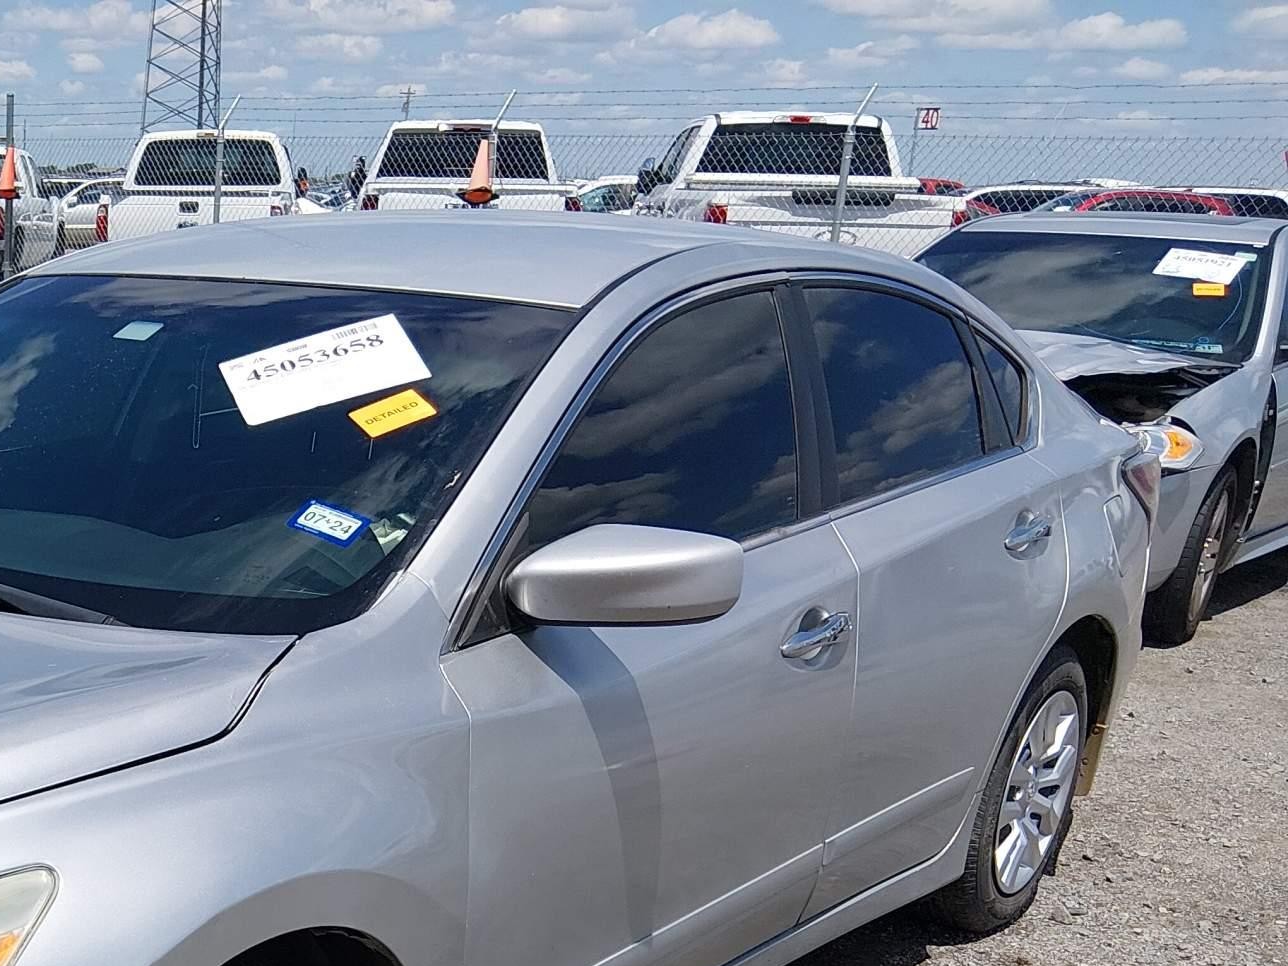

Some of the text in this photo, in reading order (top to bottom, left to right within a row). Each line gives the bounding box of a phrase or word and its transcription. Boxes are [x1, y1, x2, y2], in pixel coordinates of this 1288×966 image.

[920, 109, 940, 129] 40
[246, 334, 385, 382] 45053658
[364, 401, 419, 425] DETAILED
